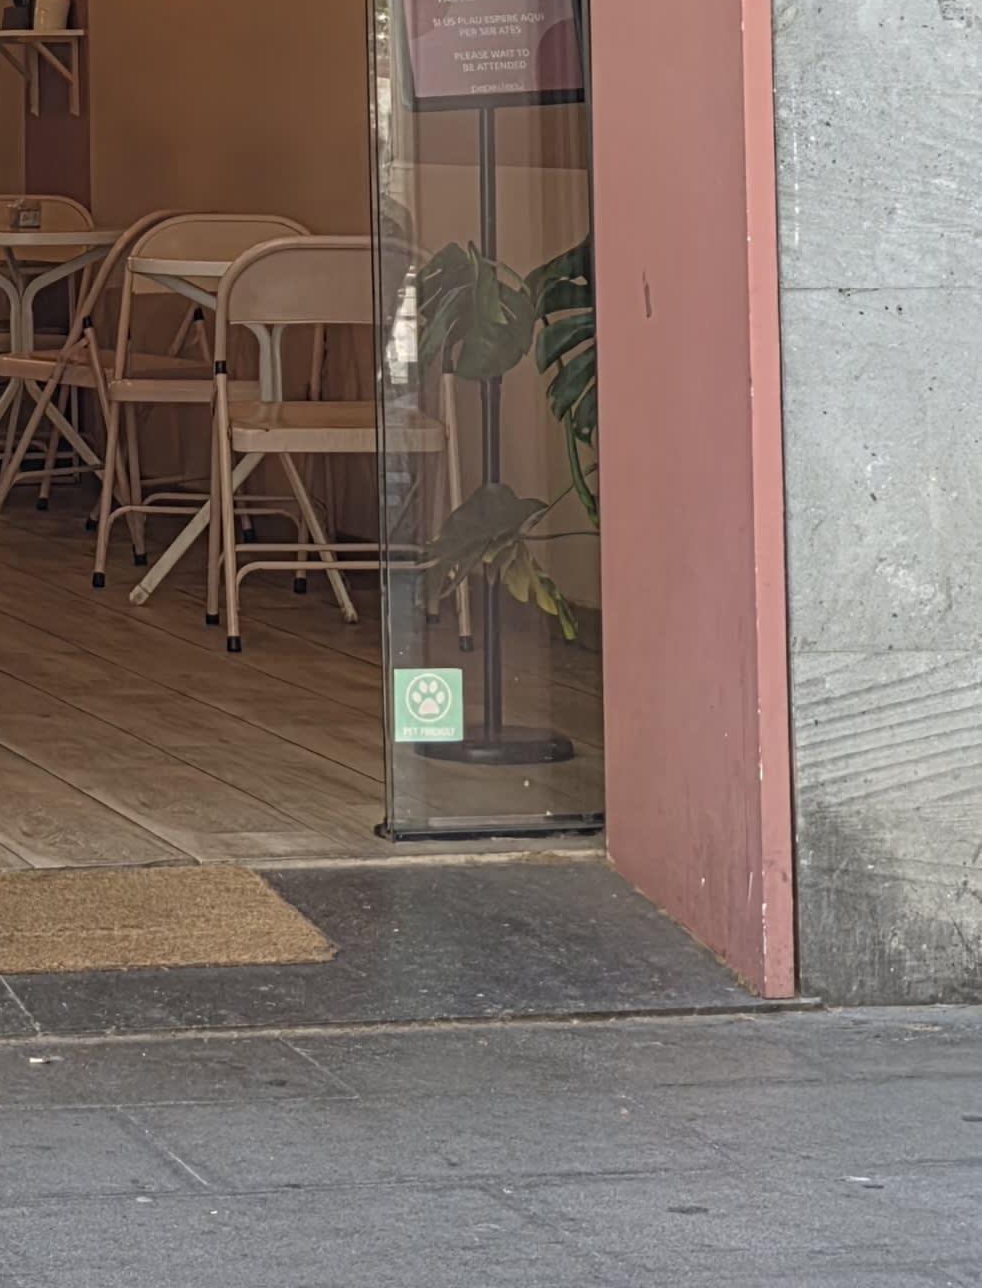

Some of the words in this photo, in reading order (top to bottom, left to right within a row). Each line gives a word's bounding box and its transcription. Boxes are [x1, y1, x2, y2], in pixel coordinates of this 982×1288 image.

[442, 16, 456, 27] US
[457, 15, 483, 26] PLAU
[453, 50, 489, 61] PLEASE
[490, 49, 515, 59] WAIT
[516, 48, 530, 58] TO
[462, 63, 476, 73] BE
[476, 60, 528, 72] ATTENDED
